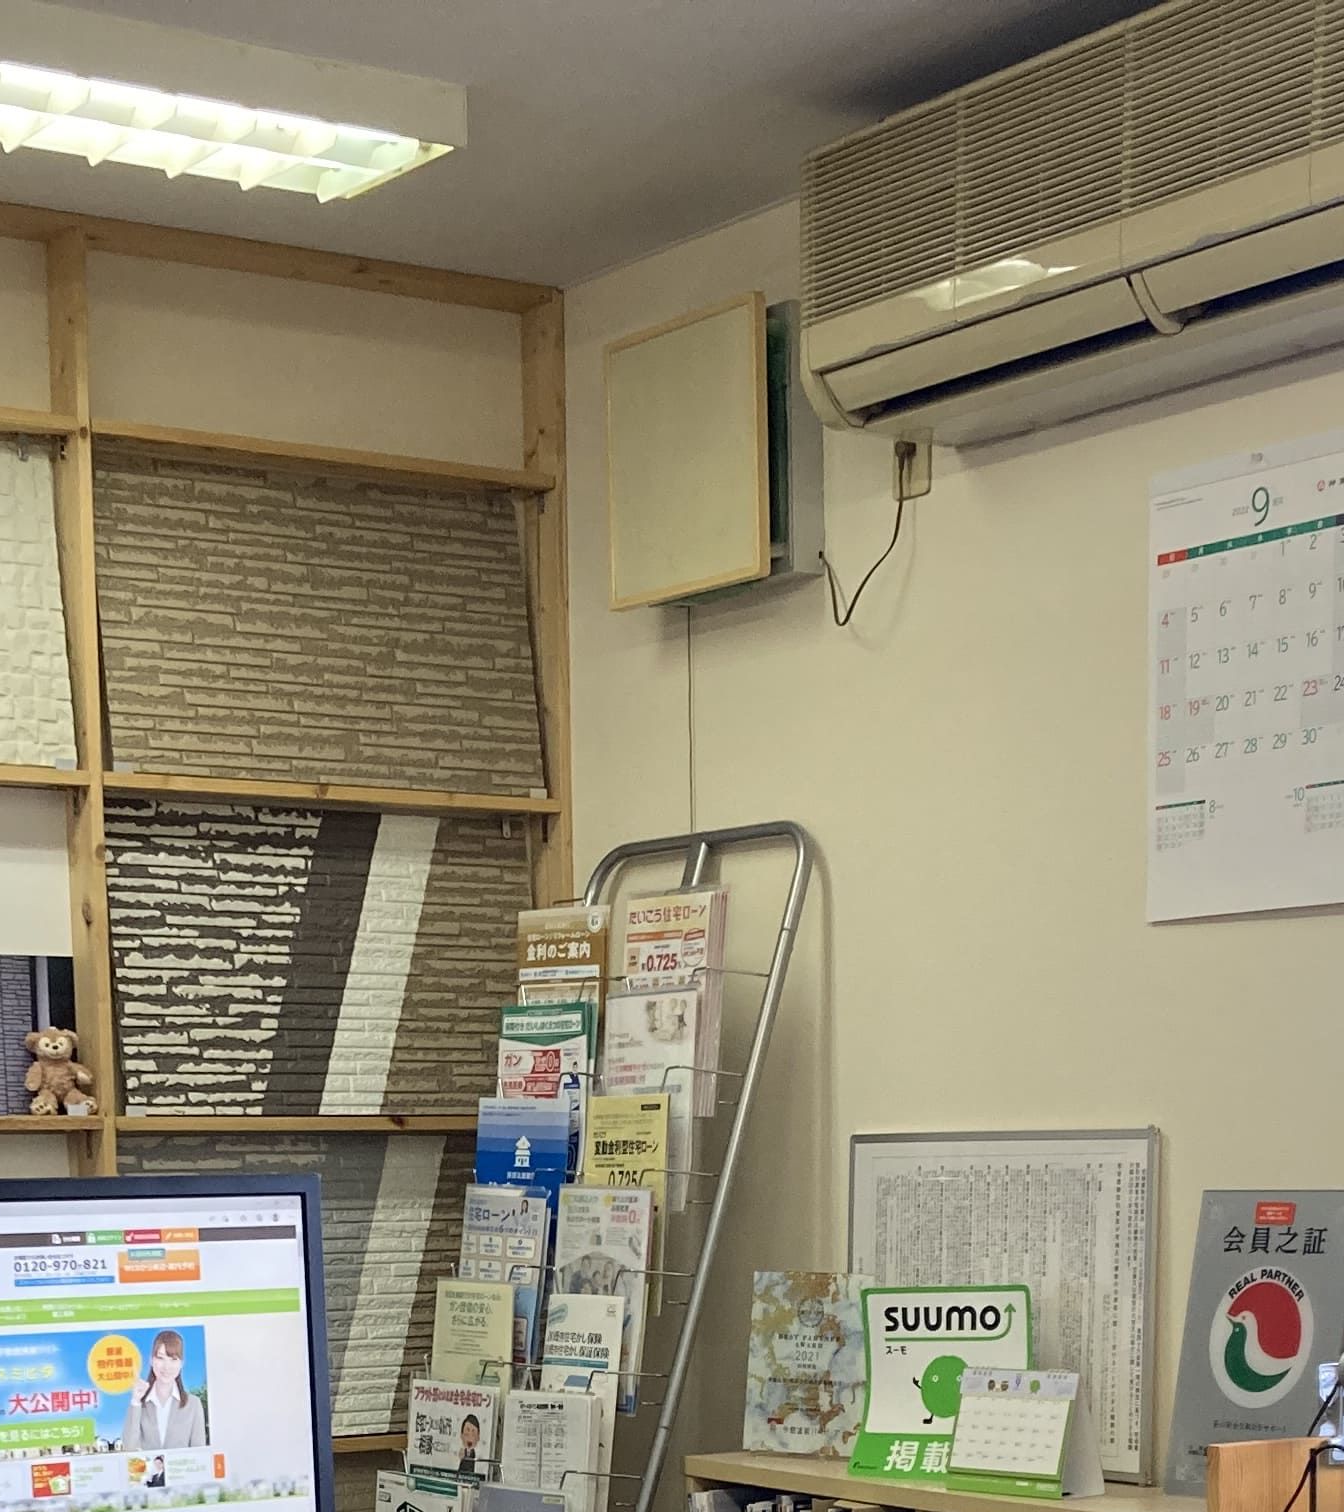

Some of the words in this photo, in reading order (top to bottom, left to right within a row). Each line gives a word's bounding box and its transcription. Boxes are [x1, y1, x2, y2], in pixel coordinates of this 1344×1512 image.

[1252, 487, 1270, 526] 9
[1280, 541, 1285, 556] 1
[1310, 534, 1317, 550] 2
[1161, 612, 1169, 628] 4
[1191, 607, 1198, 623] 5
[1220, 600, 1227, 616] 6
[1249, 595, 1256, 610] 7
[1278, 589, 1286, 605] 8
[1308, 582, 1316, 599] 9
[1160, 659, 1170, 674] 11
[1189, 653, 1200, 669] 12
[1217, 648, 1230, 664] 13
[1247, 642, 1258, 658] 14
[1277, 637, 1289, 653] 15
[1306, 631, 1318, 648] 16
[1160, 705, 1171, 720] 18
[1188, 700, 1200, 716] 19
[1215, 695, 1229, 711] 20
[1244, 691, 1256, 707] 21
[1273, 685, 1288, 702] 22
[1302, 680, 1318, 697] 23
[1157, 752, 1171, 767] 25
[1186, 747, 1200, 763] 26
[1215, 742, 1229, 759] 27
[1243, 738, 1257, 754] 28
[1272, 733, 1286, 749] 29
[1301, 728, 1316, 745] 30
[526, 941, 591, 961] 金利のご案内
[1222, 1225, 1329, 1256] 会員之証
[14, 1258, 108, 1274] 0120-970-821
[1228, 1274, 1258, 1300] REAL
[1259, 1268, 1306, 1303] PARTNER
[794, 1351, 820, 1362] 2021
[885, 1345, 908, 1355] スーモ
[8, 1390, 99, 1415] 大公開中!
